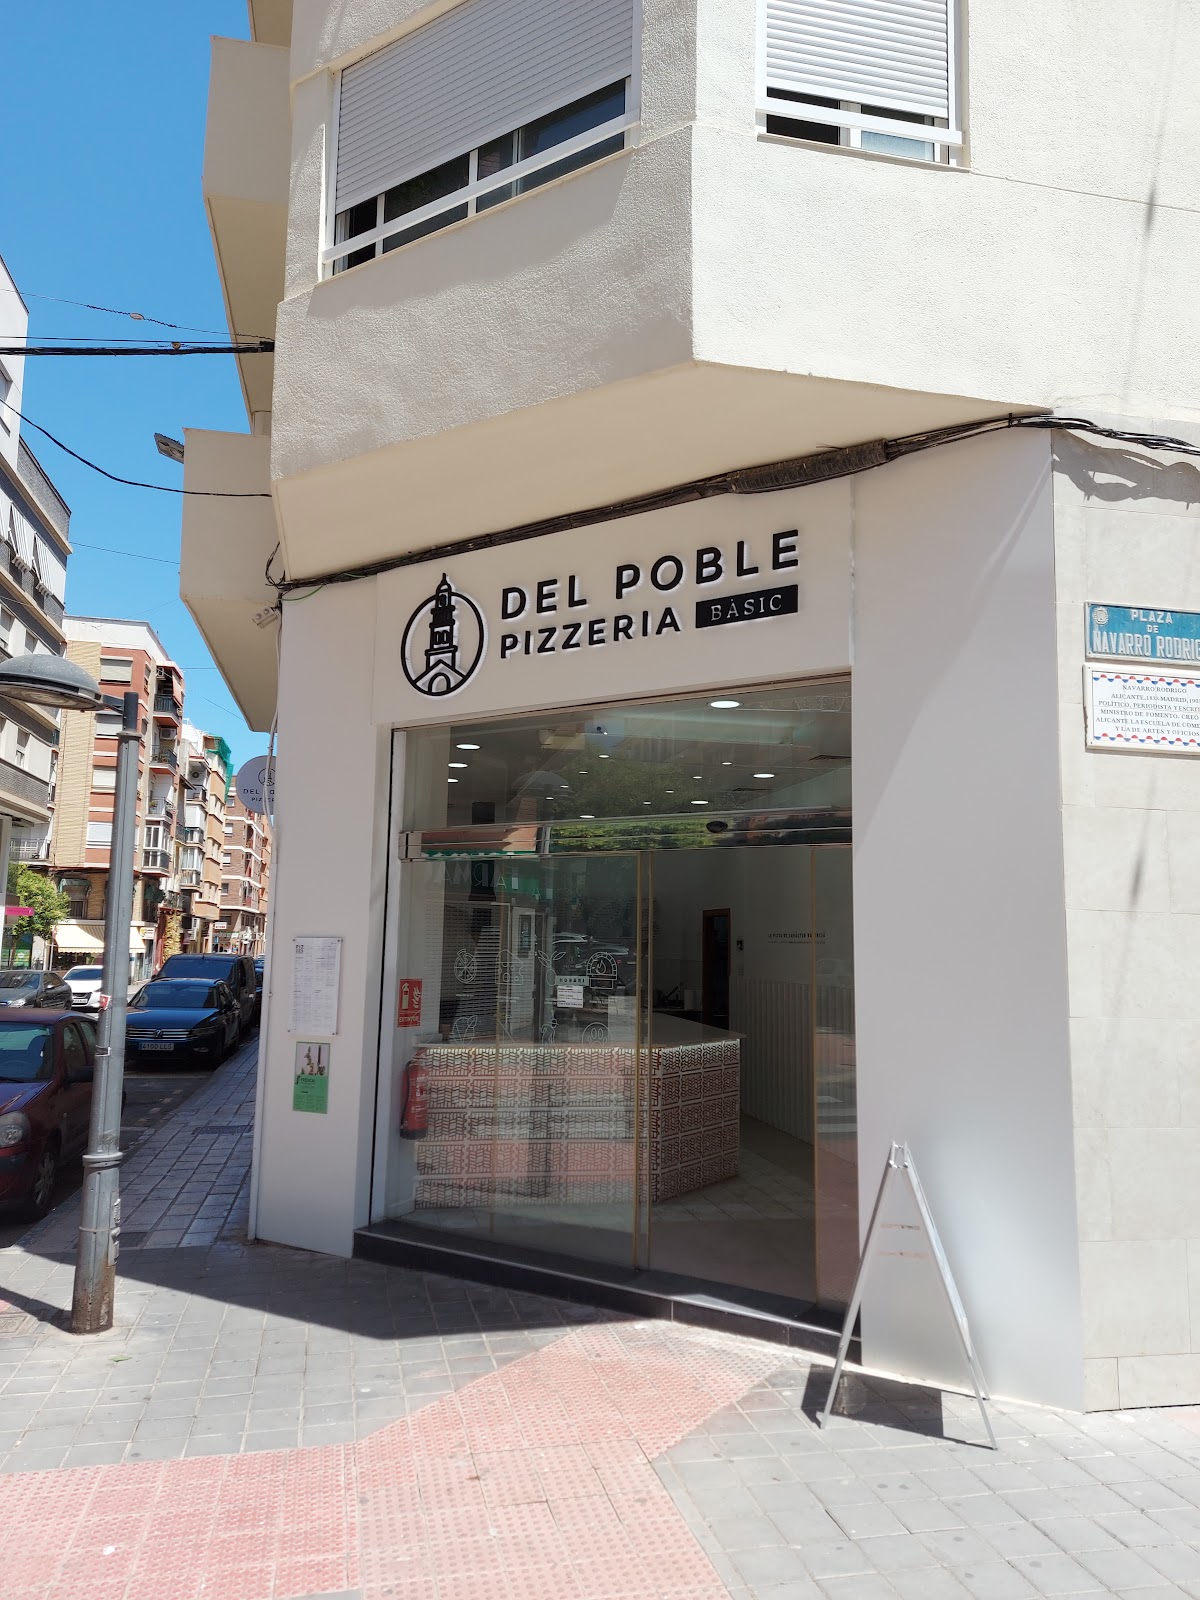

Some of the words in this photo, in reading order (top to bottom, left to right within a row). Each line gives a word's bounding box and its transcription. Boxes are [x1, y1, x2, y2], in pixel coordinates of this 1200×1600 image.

[502, 575, 587, 619] DEL
[616, 530, 798, 599] POBLE
[1131, 609, 1173, 624] PLAZA
[501, 607, 681, 659] PIZZERIA
[1147, 625, 1159, 633] DE
[1093, 630, 1152, 656] NAVARRO
[1100, 709, 1133, 717] MINISTRO
[1133, 703, 1172, 711] PERIODISTA
